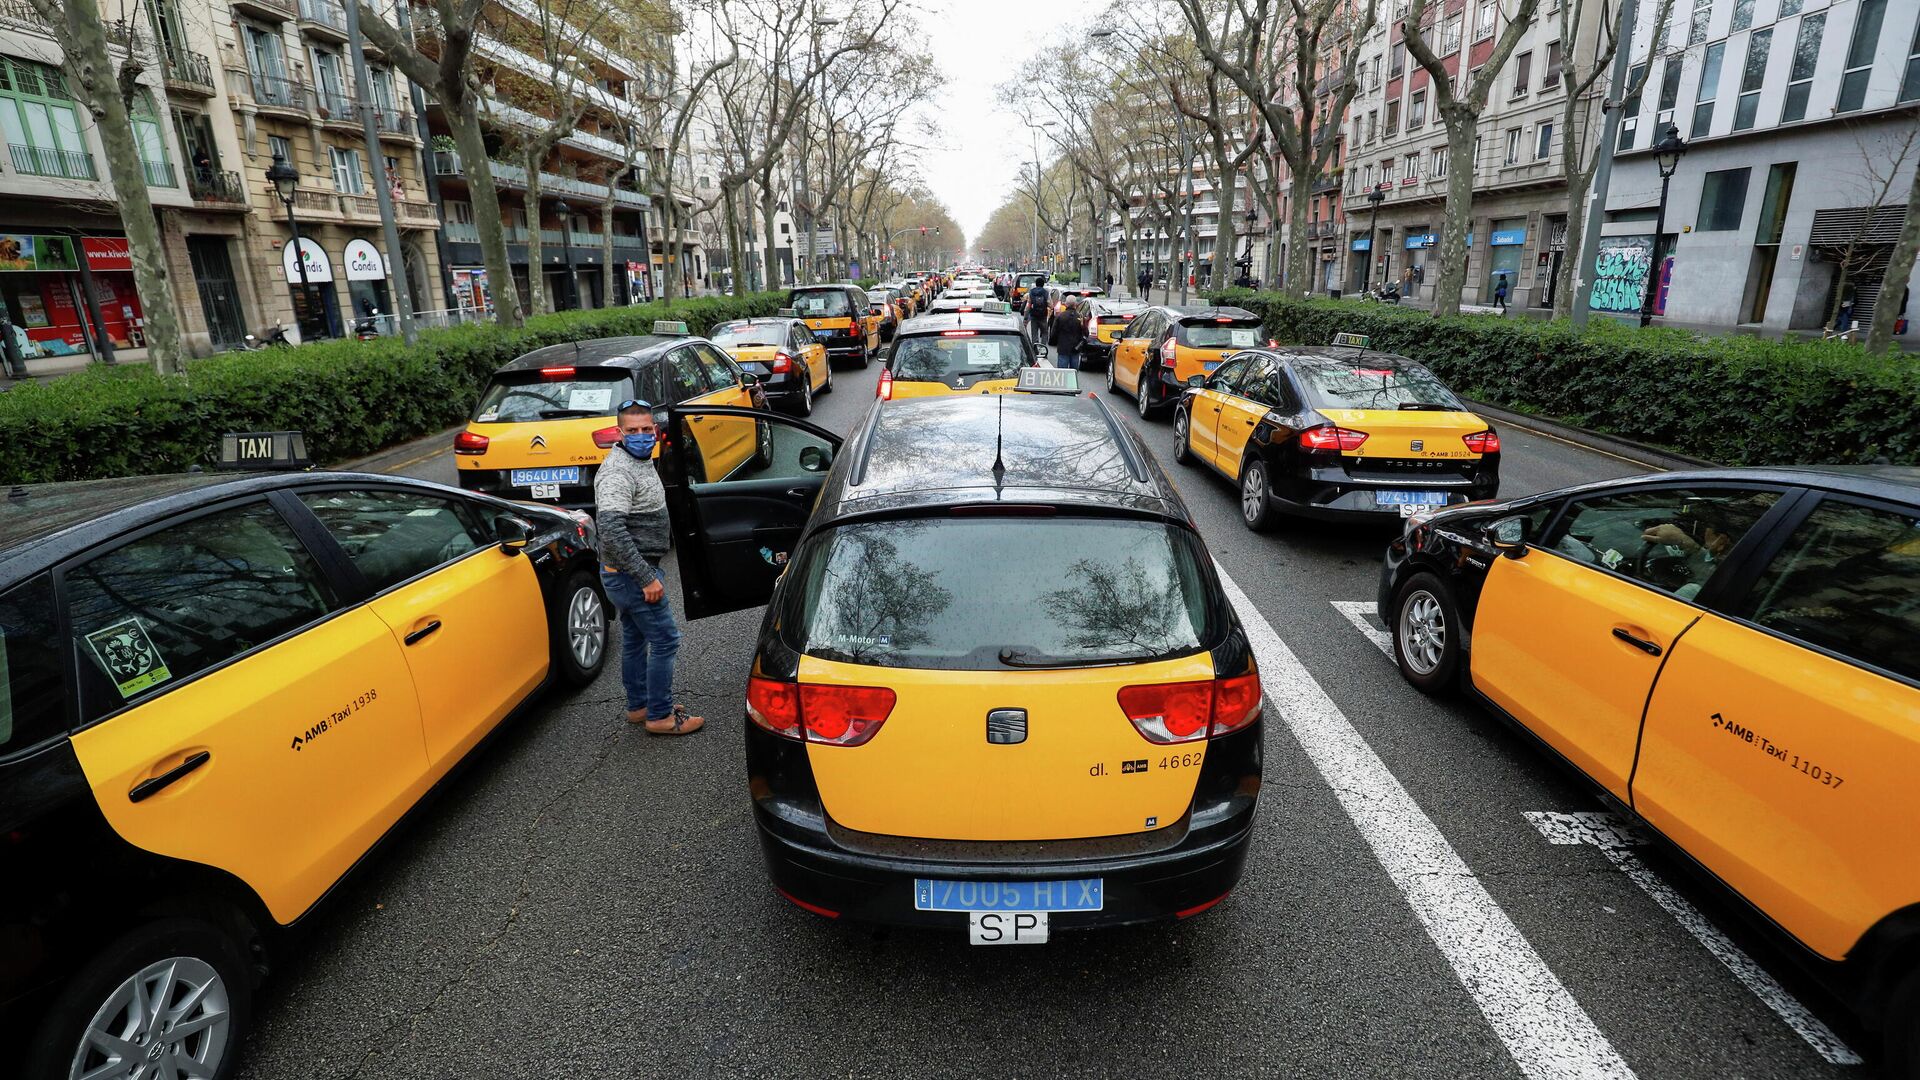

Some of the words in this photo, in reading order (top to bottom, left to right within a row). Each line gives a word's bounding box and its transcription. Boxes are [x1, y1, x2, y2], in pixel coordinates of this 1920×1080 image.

[293, 261, 323, 273] Cndis
[351, 260, 377, 272] Condis
[1348, 336, 1363, 346] TAXI
[1039, 371, 1065, 387] TAXI
[239, 438, 272, 459] TAXI
[519, 471, 548, 482] 9640
[552, 469, 574, 481] KPV
[535, 484, 556, 497] SP
[838, 634, 876, 645] M-Motor
[305, 720, 328, 743] AMB
[331, 704, 351, 725] Taxi
[353, 688, 377, 711] 1938
[1724, 721, 1755, 743] AMB
[1760, 738, 1788, 762] Taxi
[1791, 755, 1844, 789] 11037
[1090, 763, 1109, 777] dl.
[1158, 752, 1203, 770] 4662
[938, 880, 1021, 907] 7005
[980, 913, 1038, 942] SP
